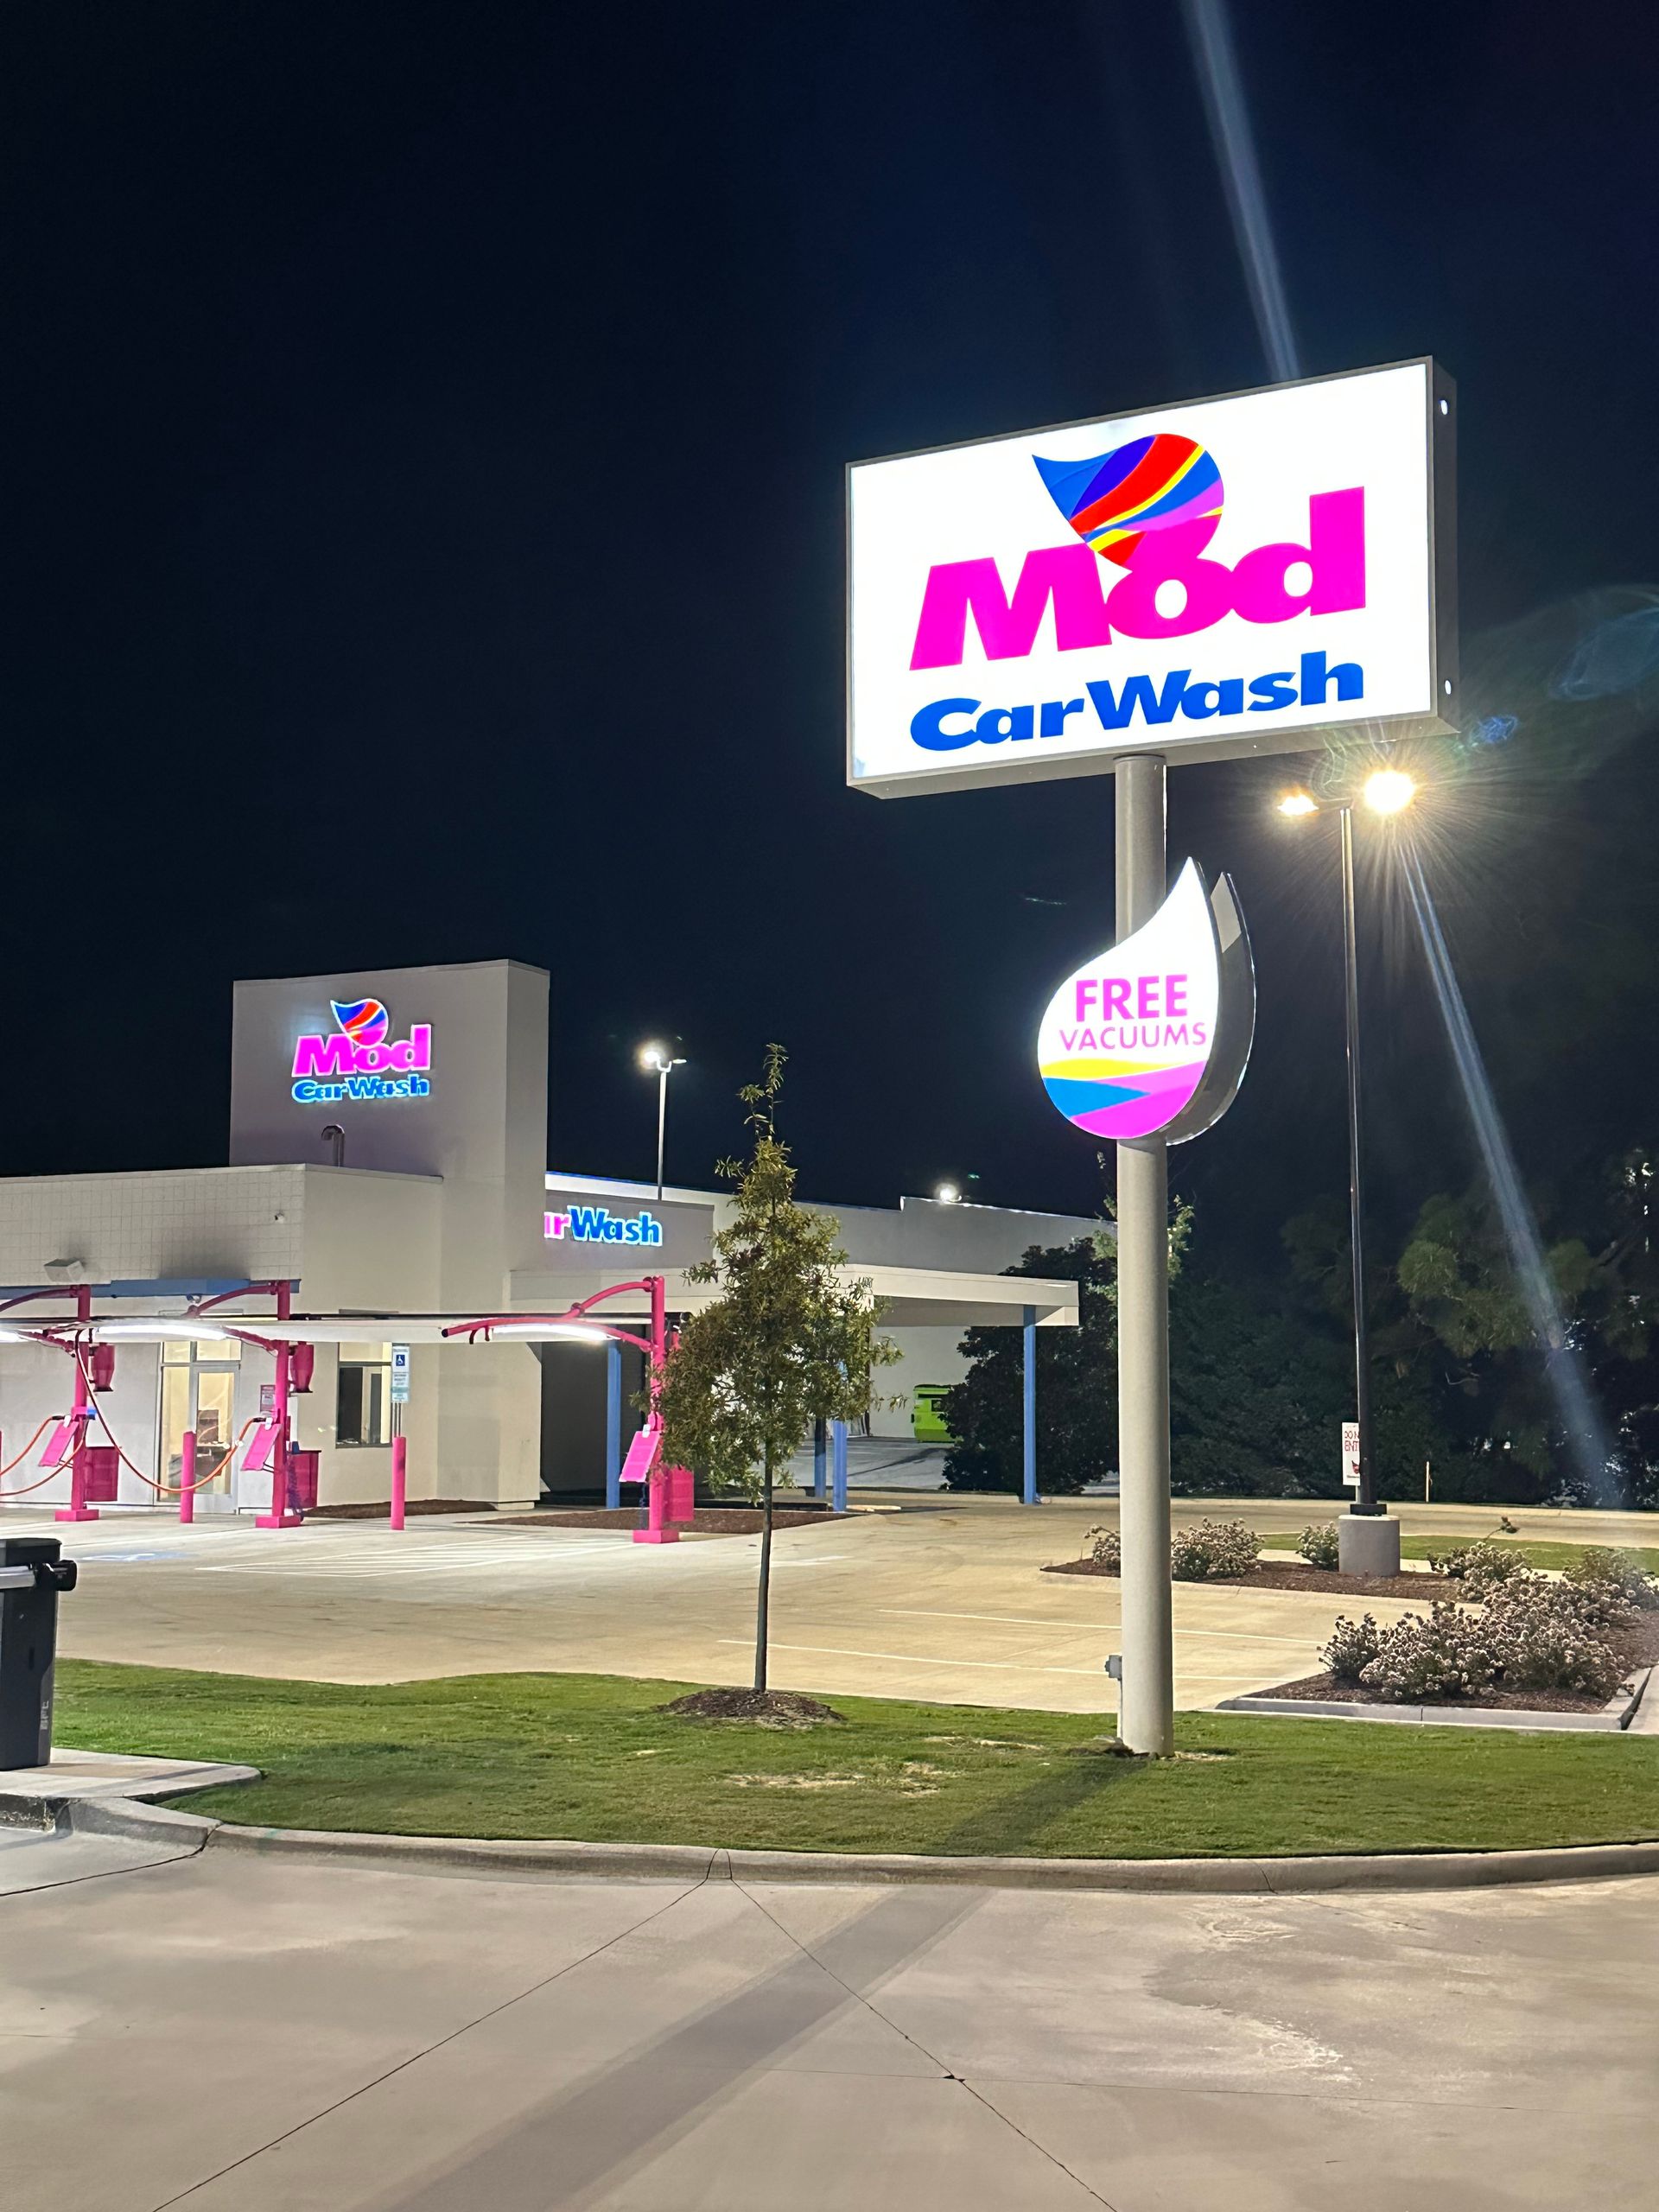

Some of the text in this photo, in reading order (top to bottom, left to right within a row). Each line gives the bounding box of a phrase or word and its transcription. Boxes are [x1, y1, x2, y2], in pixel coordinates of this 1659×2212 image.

[910, 486, 1366, 671] Mod
[1075, 974, 1188, 1022] FREE
[291, 1024, 432, 1077] Mod
[1059, 1022, 1207, 1052] VACUUMS
[1344, 1440, 1360, 1452] ENT
